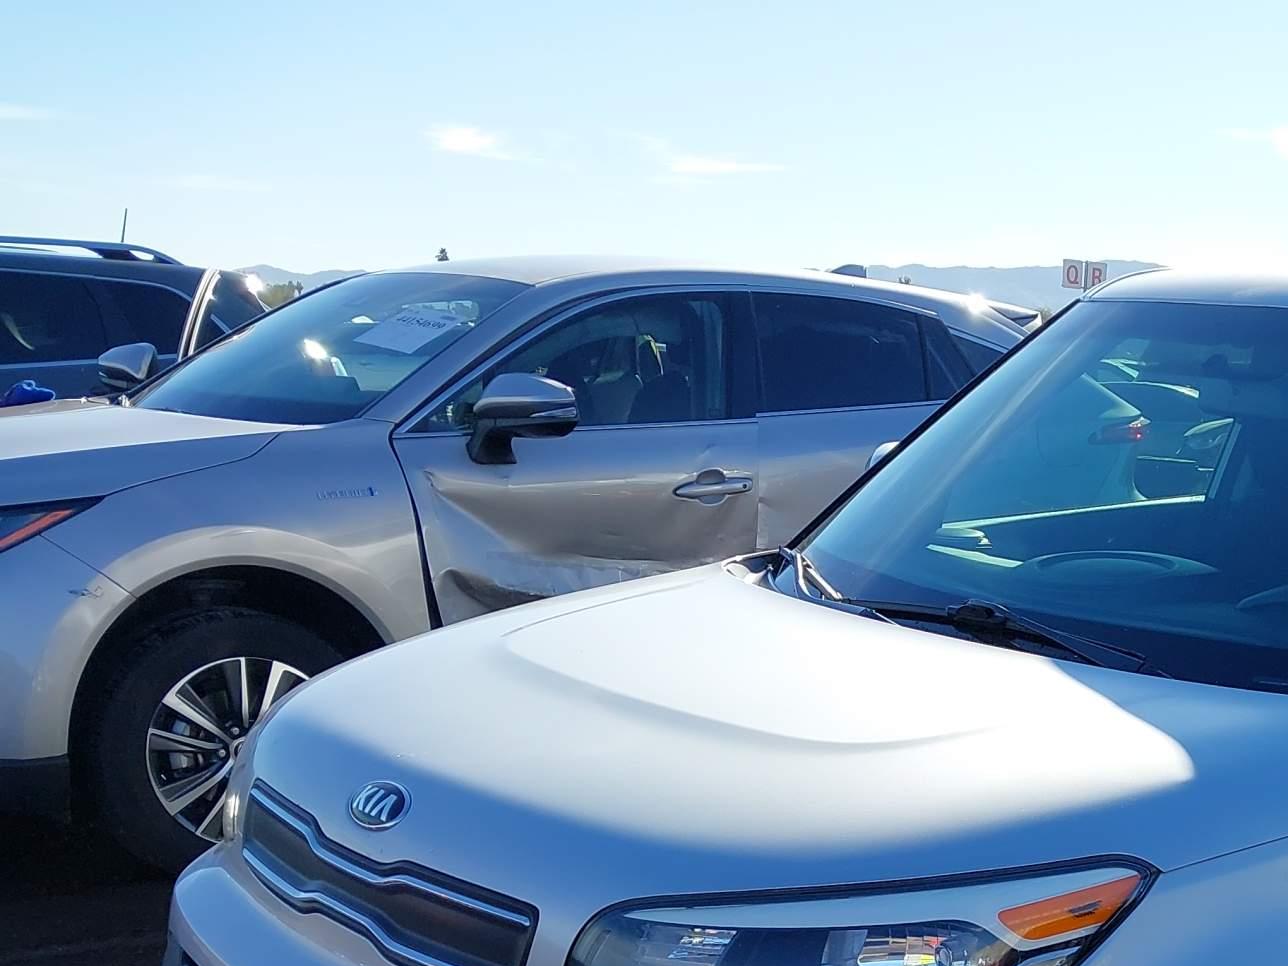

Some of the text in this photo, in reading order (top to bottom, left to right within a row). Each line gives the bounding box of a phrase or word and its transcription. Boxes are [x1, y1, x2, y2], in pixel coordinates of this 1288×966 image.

[1066, 265, 1079, 284] Q
[1092, 267, 1102, 287] R
[352, 785, 398, 822] KIA
